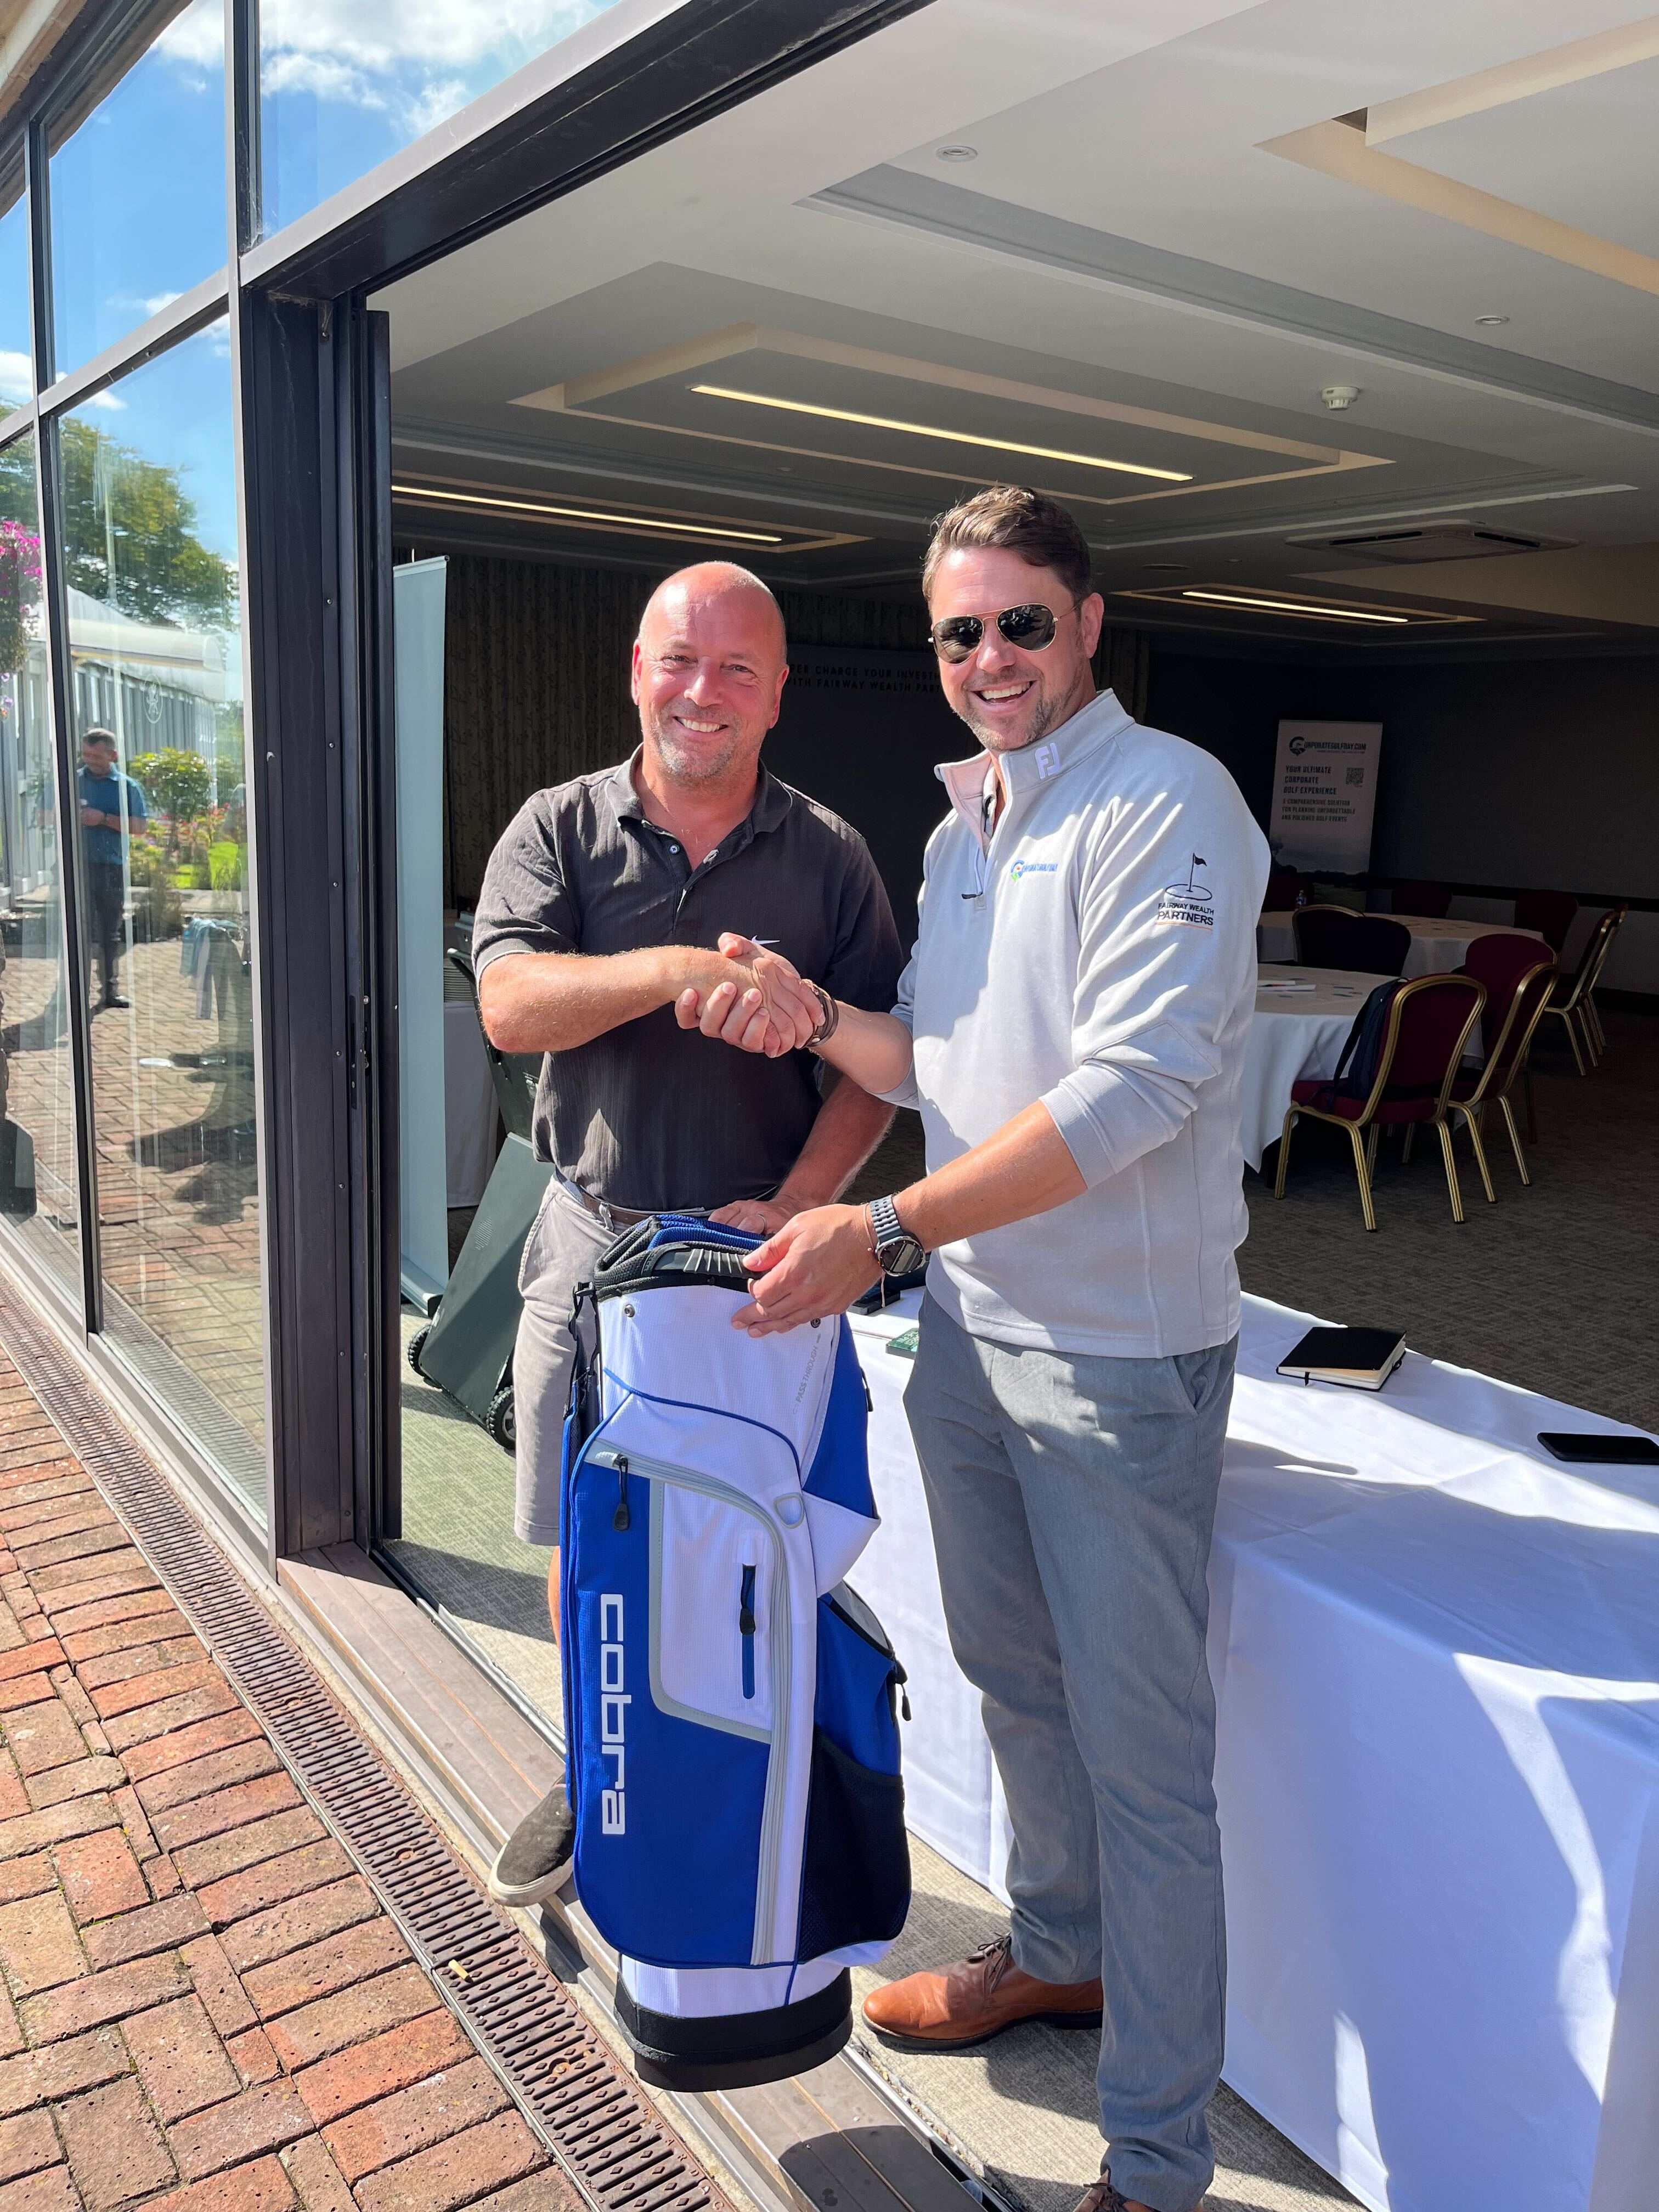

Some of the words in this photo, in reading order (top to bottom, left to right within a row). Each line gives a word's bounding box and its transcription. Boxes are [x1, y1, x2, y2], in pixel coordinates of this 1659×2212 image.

[815, 665, 858, 676] CHARGE
[864, 667, 891, 678] YOUR
[817, 679, 865, 690] FAIRWAY
[870, 681, 911, 692] WEALTH
[1035, 743, 1060, 779] FJ
[1286, 765, 1301, 773] YOUR
[1284, 776, 1319, 784] CORPORATE
[1189, 904, 1214, 915] WEALTH
[1157, 911, 1214, 926] PARTNERS
[795, 1382, 807, 1403] PASS
[802, 1345, 818, 1382] THROUGH
[601, 1593, 632, 1835] cobra
